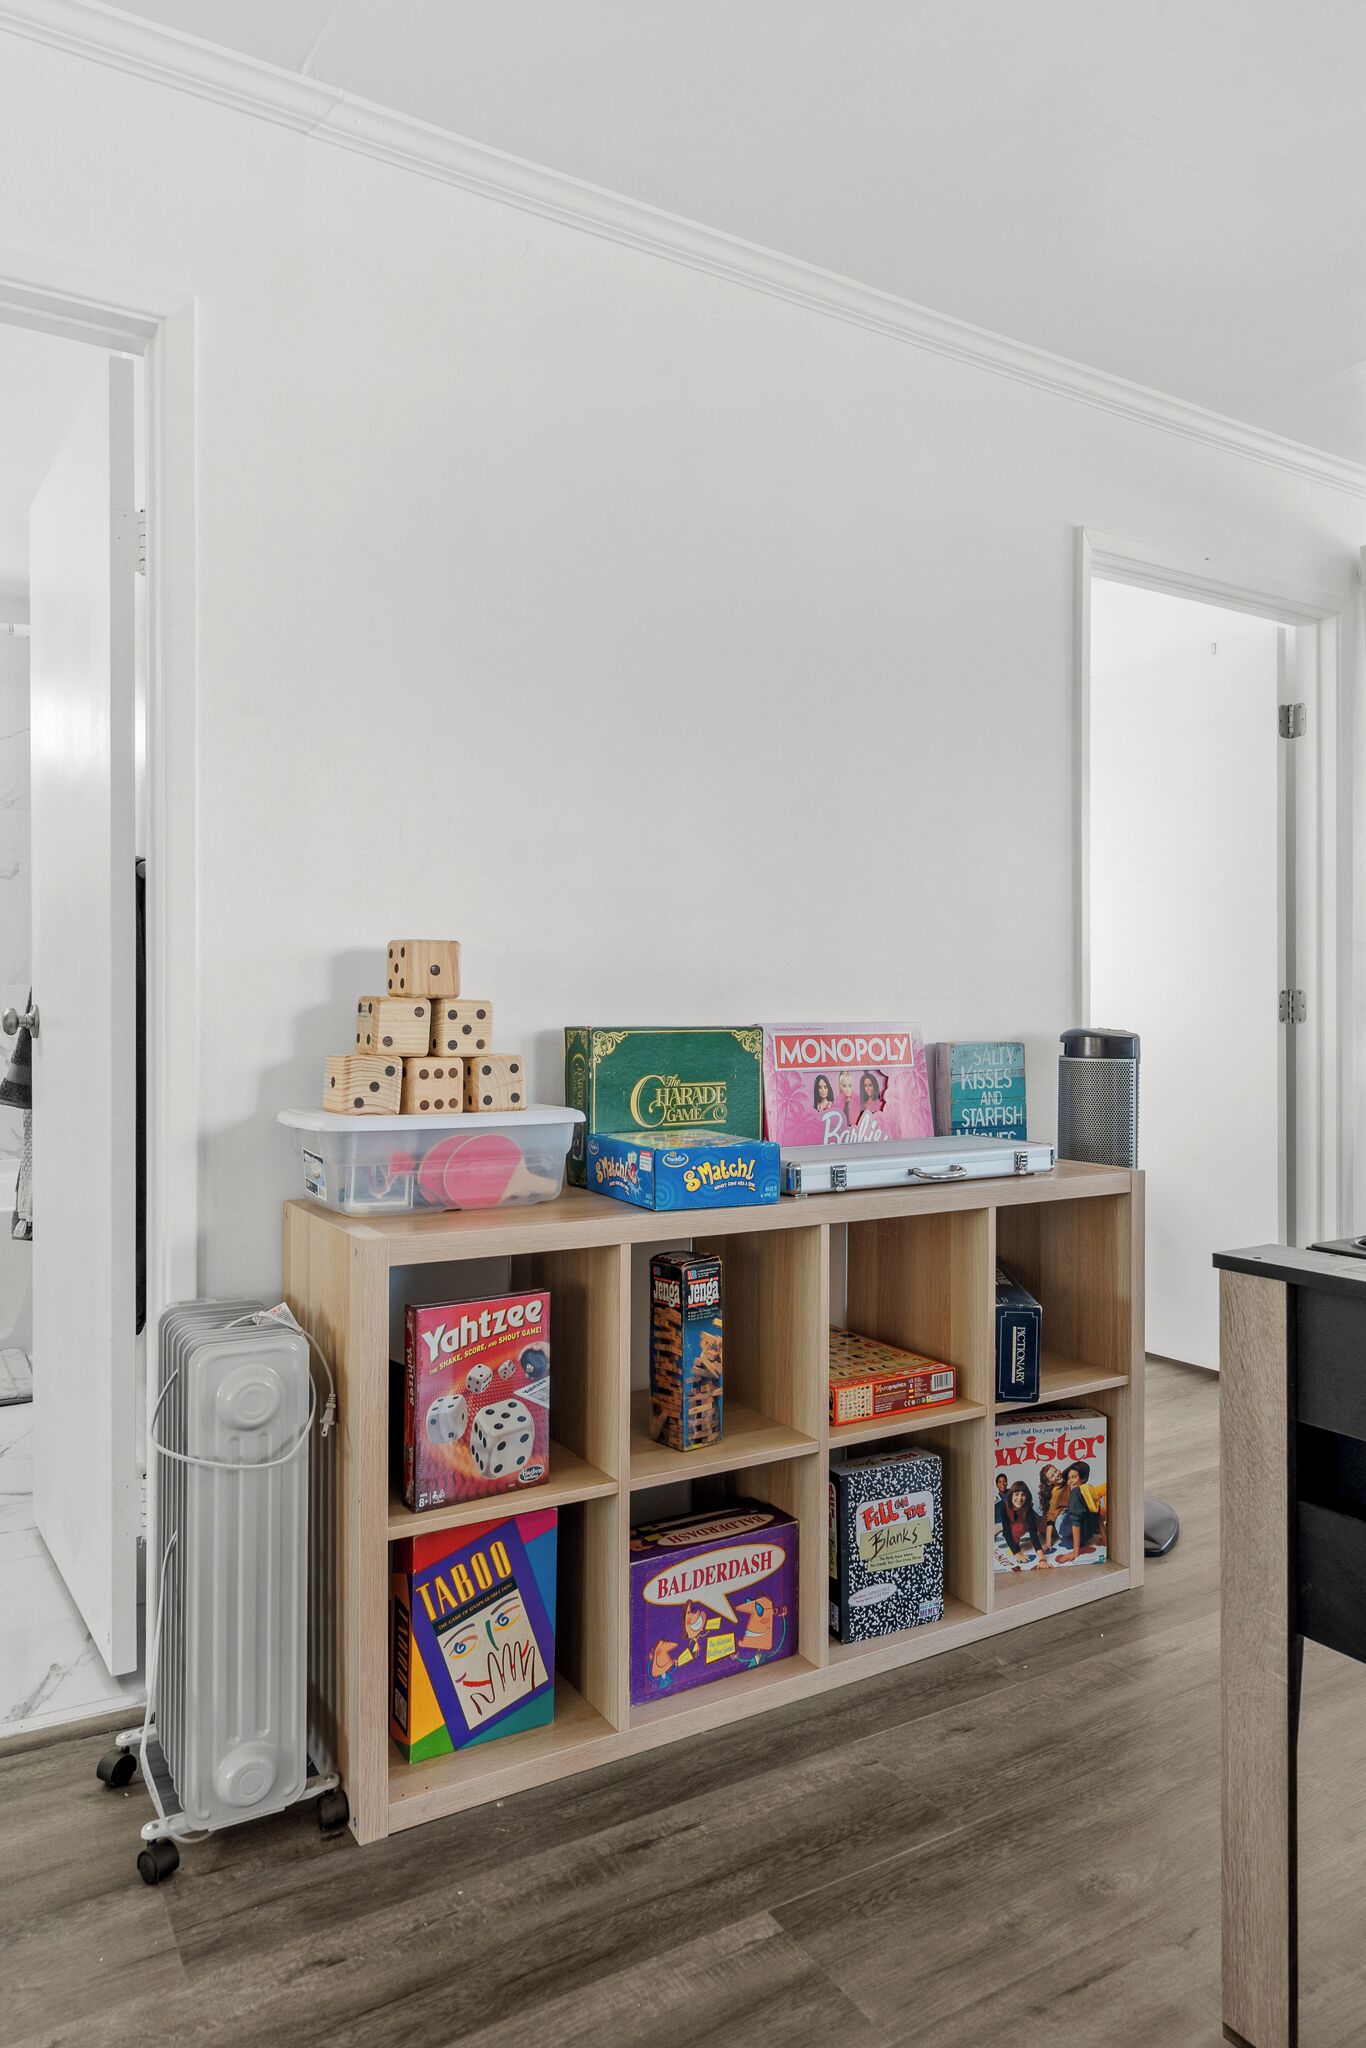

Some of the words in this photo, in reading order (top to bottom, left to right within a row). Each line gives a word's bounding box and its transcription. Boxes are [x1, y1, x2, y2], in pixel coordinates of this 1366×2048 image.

[780, 1037, 908, 1064] MONOPOLY
[973, 1046, 1014, 1066] SALTY
[664, 1074, 681, 1087] The
[630, 1074, 727, 1128] CHARADE
[980, 1090, 1003, 1106] AND
[667, 1108, 702, 1122] GAME
[822, 1110, 888, 1145] Barbie
[961, 1105, 1023, 1127] STARFISH
[687, 1277, 719, 1305] Jenga
[421, 1300, 542, 1363] Yahtzee
[439, 1353, 463, 1370] SHAKE,
[464, 1344, 487, 1358] SCORE,
[488, 1340, 497, 1348] AND
[498, 1331, 520, 1344] SHOUT
[521, 1326, 542, 1337] GAME!
[1016, 1326, 1026, 1383] PICTIONARY
[1069, 1424, 1087, 1432] knots.
[995, 1432, 1105, 1468] wister
[904, 1503, 927, 1521] THE
[667, 1515, 766, 1544] BALDERDASH
[415, 1540, 513, 1622] TABOO
[657, 1550, 773, 1600] BALDERDASH
